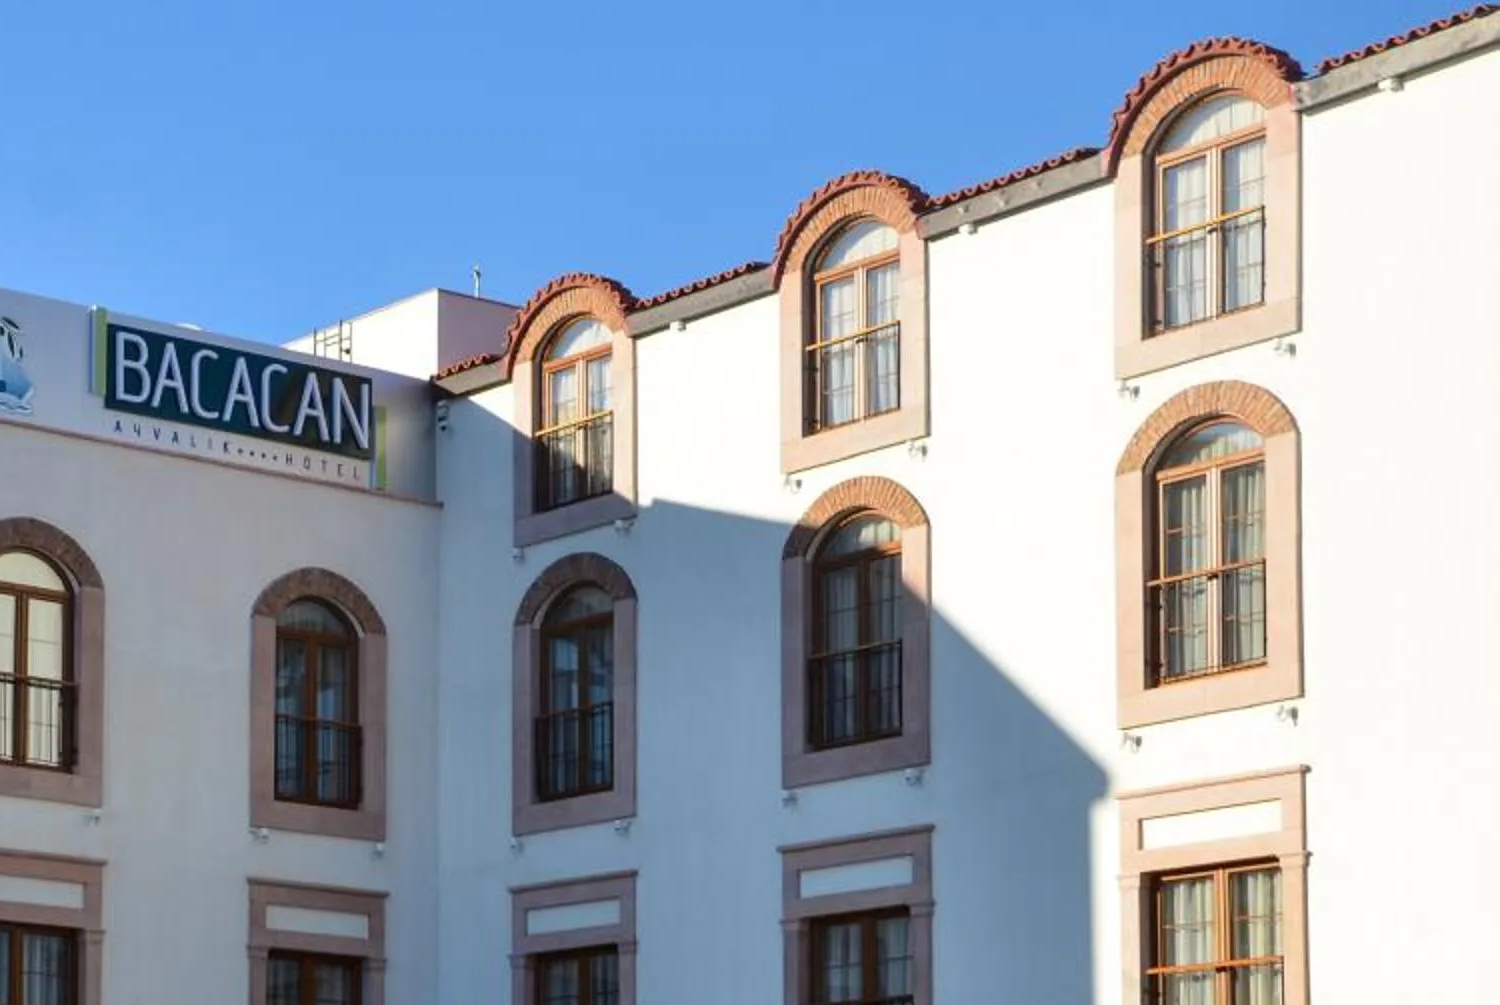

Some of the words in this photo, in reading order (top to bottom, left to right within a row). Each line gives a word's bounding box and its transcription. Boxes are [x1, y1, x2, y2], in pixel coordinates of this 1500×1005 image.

[114, 330, 370, 449] BACACAN
[113, 420, 231, 454] AYVALIK
[285, 452, 360, 480] HOTEL
